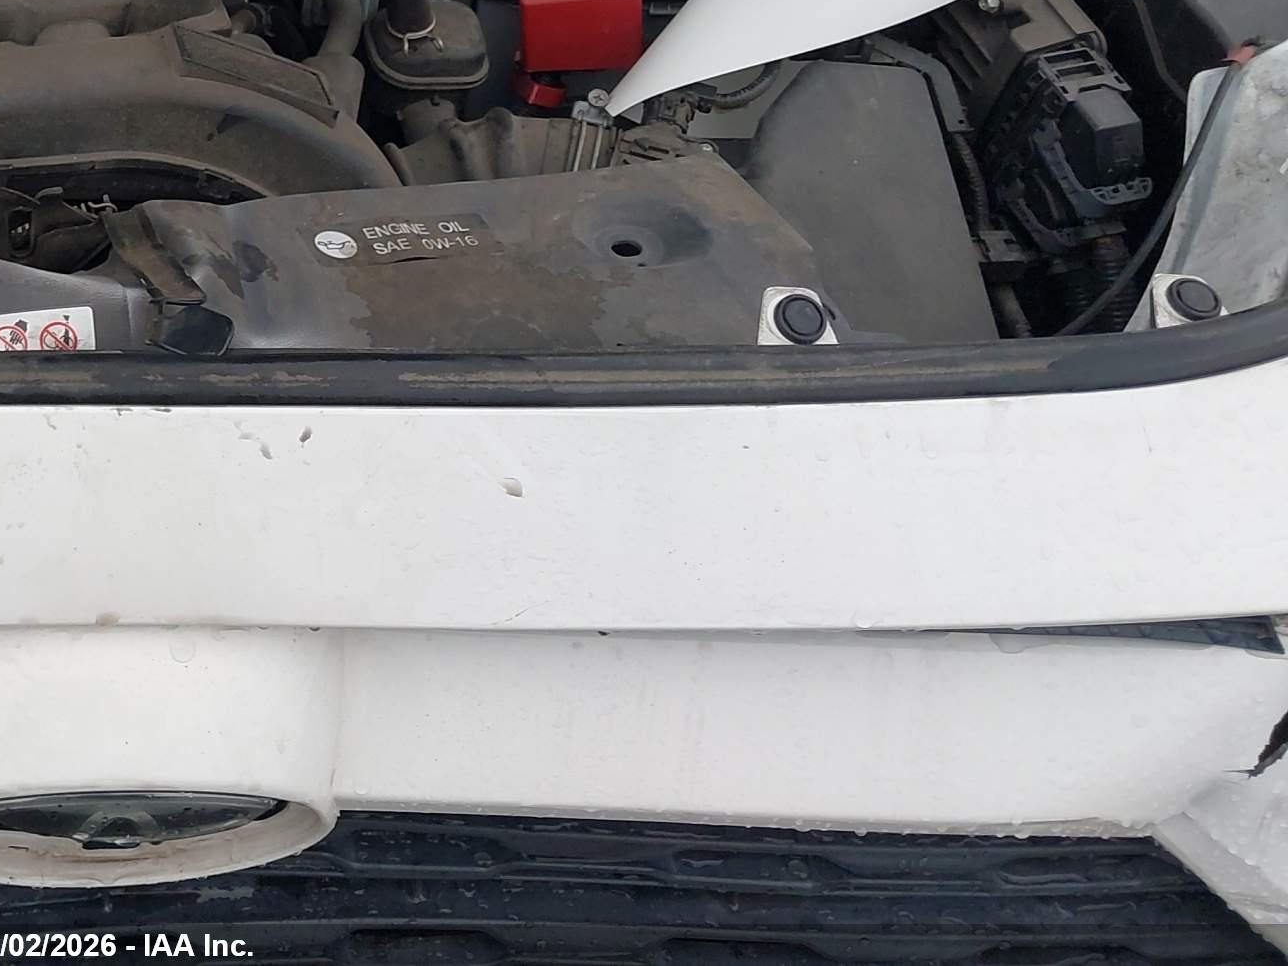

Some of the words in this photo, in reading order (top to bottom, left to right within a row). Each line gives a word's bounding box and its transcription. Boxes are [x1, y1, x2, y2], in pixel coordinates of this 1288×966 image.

[362, 223, 429, 239] ENGINE
[438, 221, 470, 233] OIL
[373, 239, 412, 255] SAE
[422, 236, 478, 250] 0W-16
